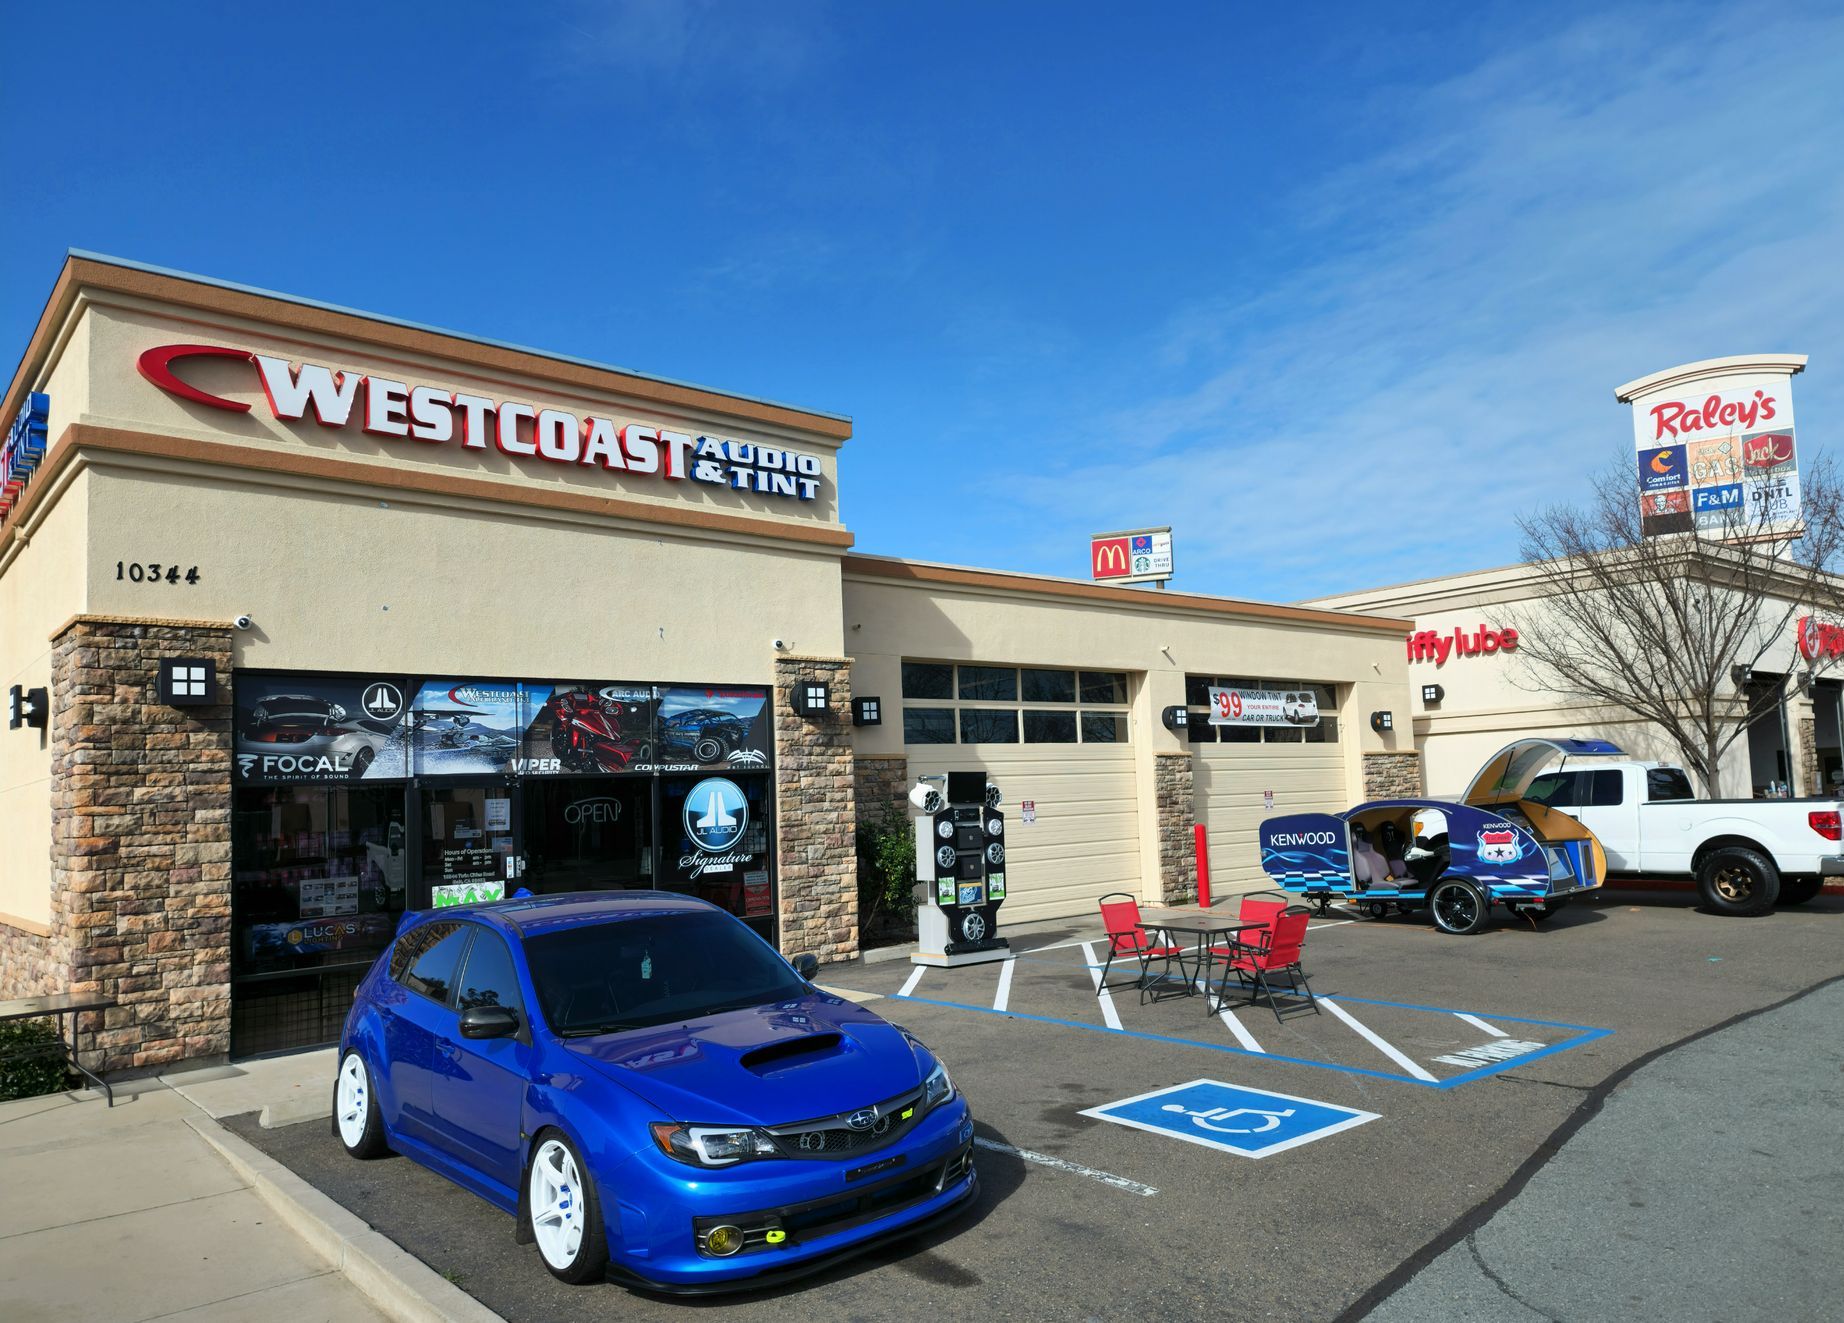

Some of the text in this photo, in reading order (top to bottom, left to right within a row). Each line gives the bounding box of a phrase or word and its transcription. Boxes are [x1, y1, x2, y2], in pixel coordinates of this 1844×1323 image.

[252, 354, 693, 480] WESTCOAST
[1650, 390, 1776, 440] Raley's
[696, 436, 821, 476] AUDIO
[1746, 437, 1791, 464] Jack
[691, 459, 821, 500] & TINT
[1646, 474, 1680, 484] Comfort
[1693, 457, 1739, 480] GAS
[1696, 488, 1739, 507] F&M
[116, 561, 201, 584] 10344
[1455, 624, 1519, 656] lube
[612, 690, 630, 698] ARC
[1213, 691, 1282, 718] $99 WINDOW TINT
[1242, 714, 1285, 722] CAR OR TRUCK
[263, 755, 349, 773] FOCAL
[511, 758, 561, 771] VIPER
[564, 803, 618, 824] OPEN
[696, 826, 738, 836] JL AUDIO
[1270, 831, 1336, 847] KENWOOD
[679, 850, 753, 880] Signature
[304, 923, 356, 939] LUCAS
